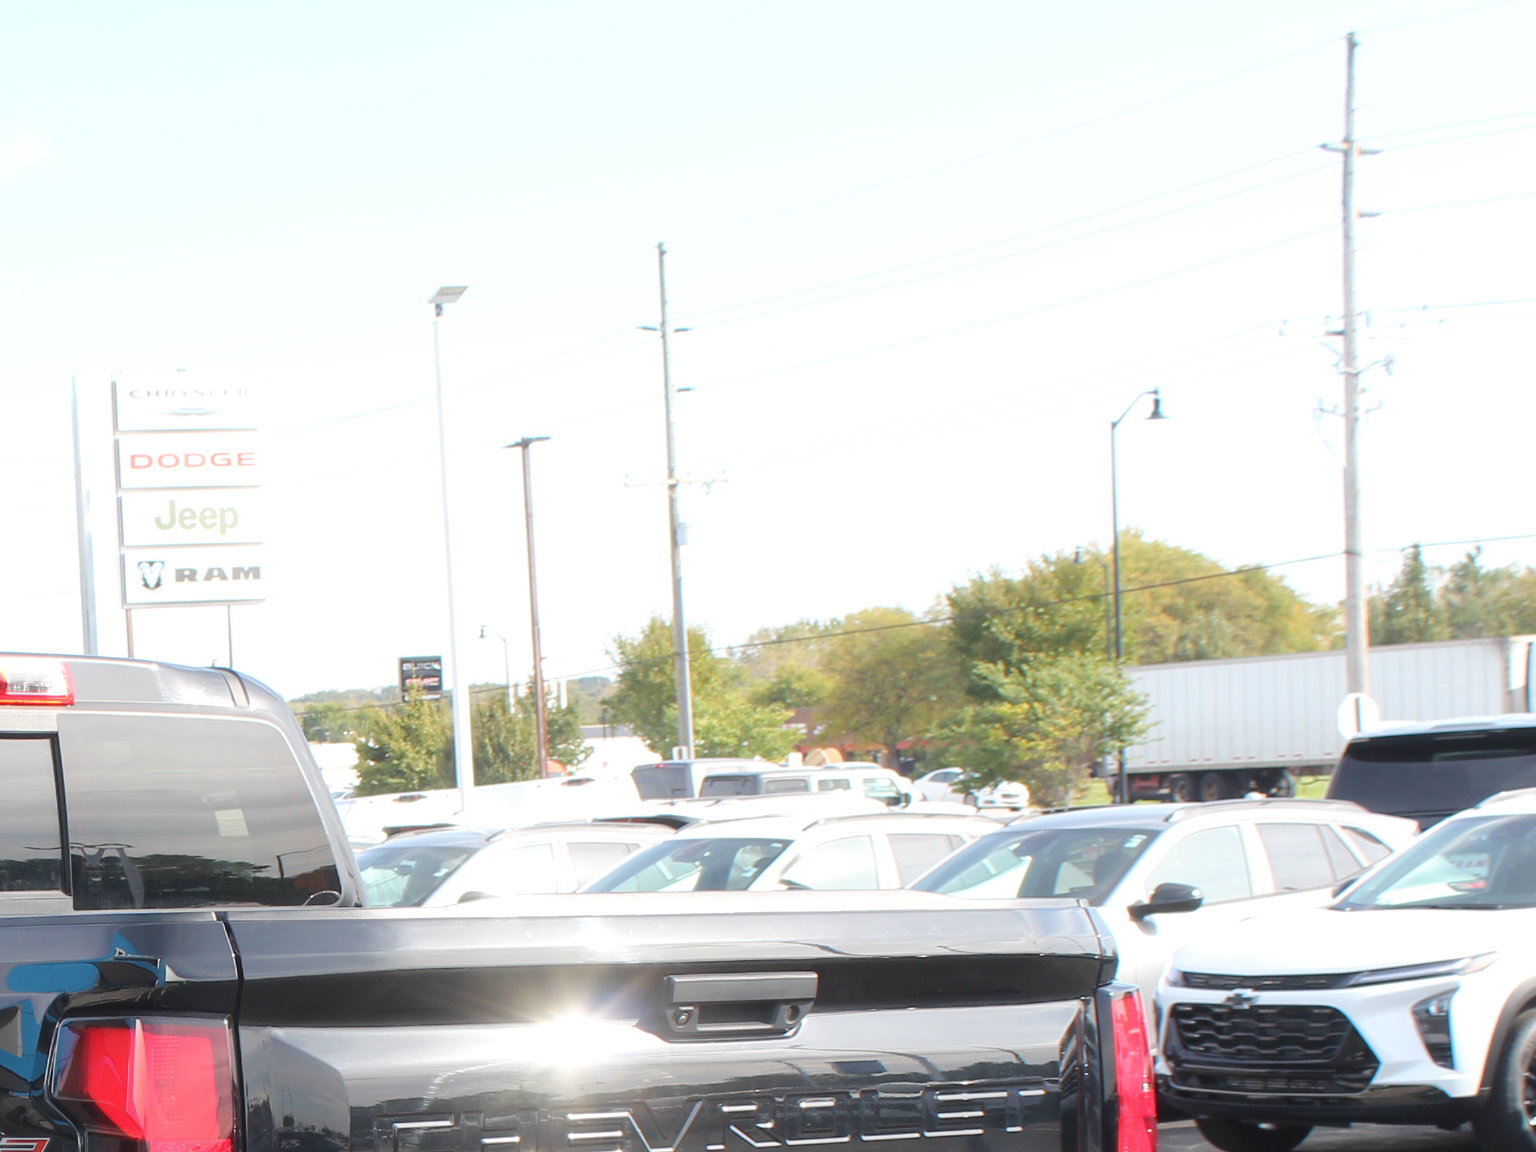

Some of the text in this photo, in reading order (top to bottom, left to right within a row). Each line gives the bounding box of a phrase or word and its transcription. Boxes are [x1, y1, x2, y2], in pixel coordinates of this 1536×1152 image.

[129, 389, 248, 398] CHRYSLR
[130, 452, 256, 469] DODGE
[155, 500, 239, 535] Jeep
[175, 566, 261, 582] RAM
